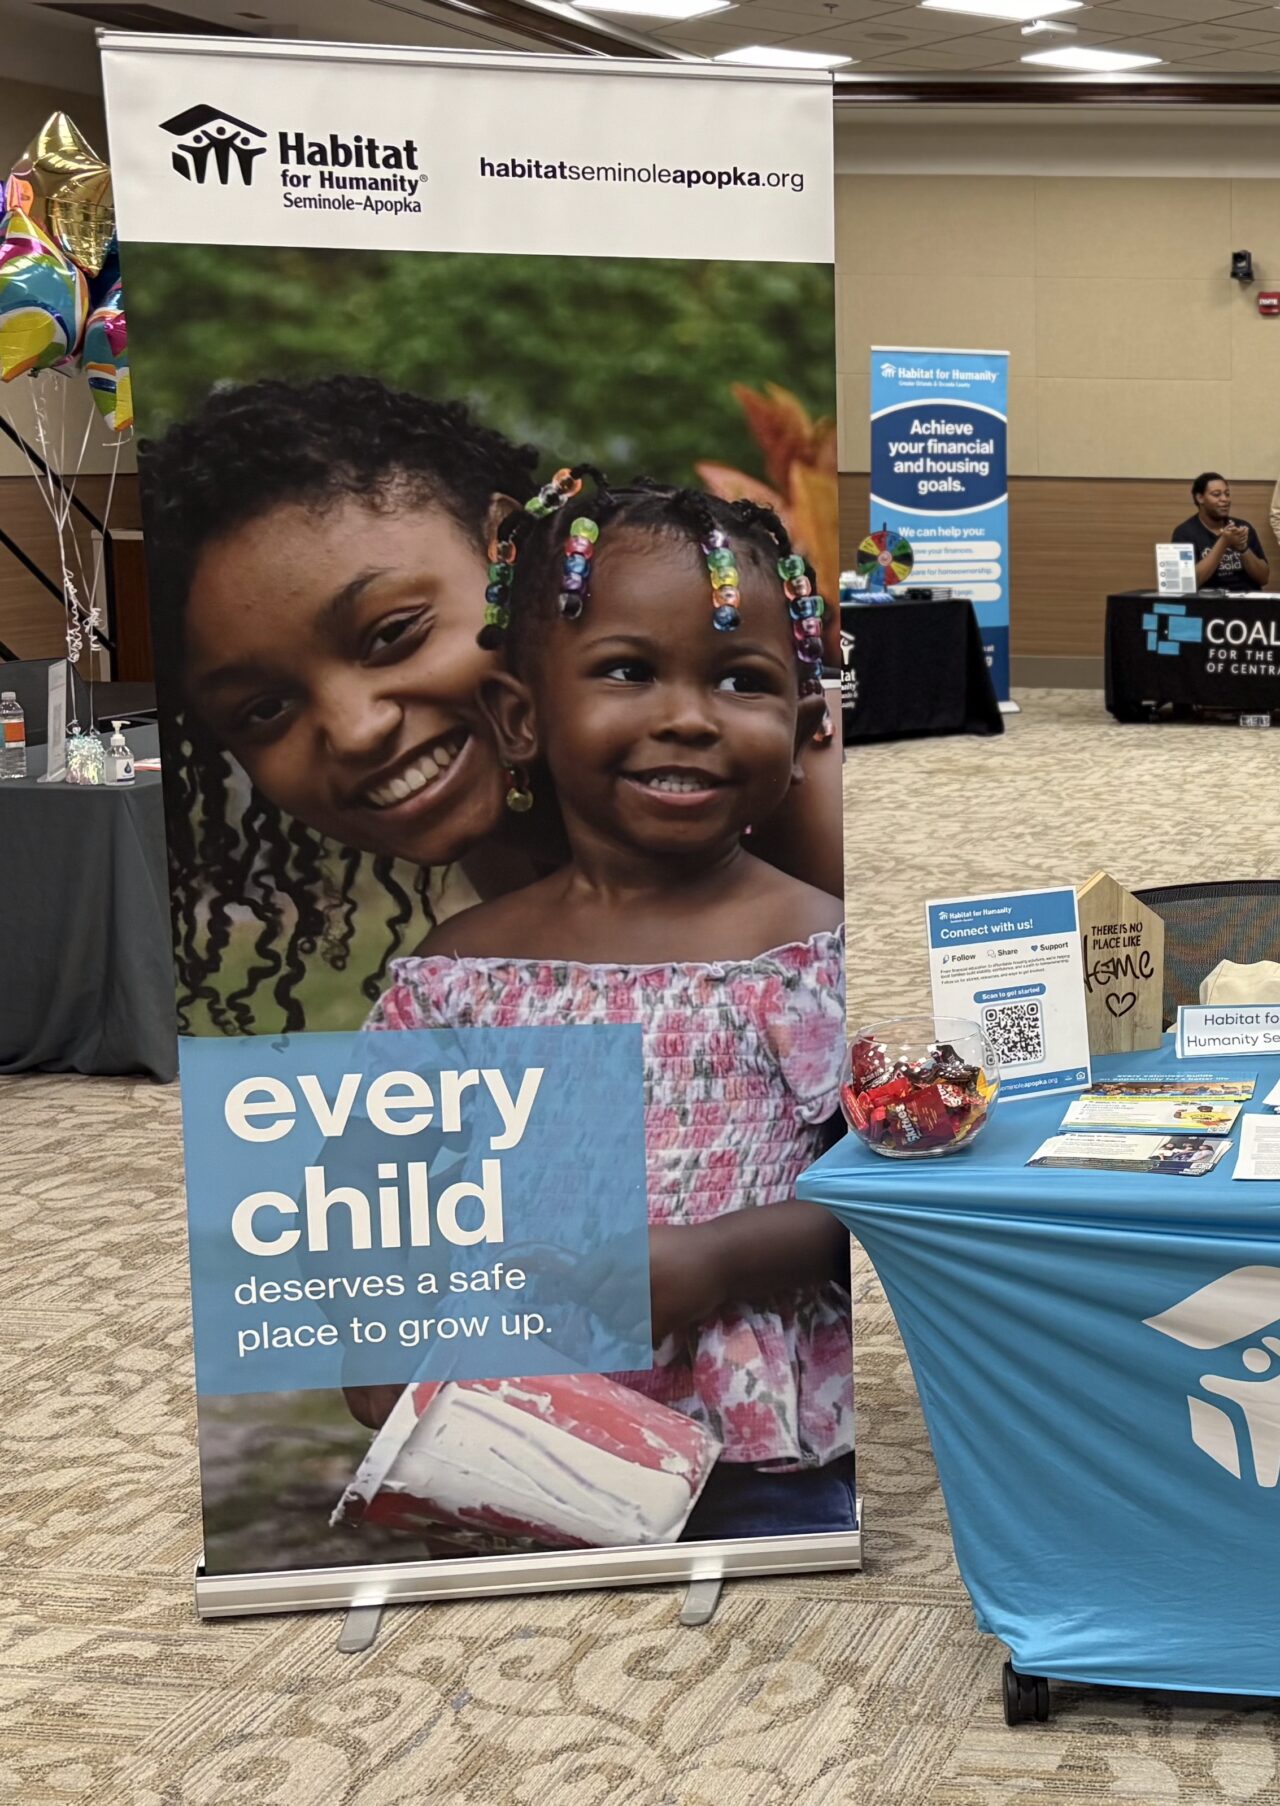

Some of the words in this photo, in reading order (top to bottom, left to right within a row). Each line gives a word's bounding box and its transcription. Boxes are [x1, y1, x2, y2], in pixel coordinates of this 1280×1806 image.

[278, 131, 419, 171] Habitat
[281, 170, 312, 191] for
[479, 156, 804, 192] habitatseminoleapopka.org
[283, 191, 422, 215] Seminole-Apopka
[898, 368, 934, 379] Habitat
[936, 369, 949, 380] for
[952, 369, 996, 383] Humanity
[910, 419, 974, 435] Achieve
[888, 441, 925, 457] your
[927, 439, 994, 454] financial
[894, 458, 924, 473] and
[926, 458, 990, 476] housing
[917, 477, 966, 495] goals.
[898, 527, 916, 537] We
[916, 529, 936, 537] can
[938, 526, 962, 538] help
[963, 528, 986, 538] you:
[1209, 649, 1237, 661] FOR
[1246, 650, 1273, 661] THE
[1206, 662, 1225, 674] OF
[949, 911, 972, 919] Habitat
[940, 925, 989, 940] Connect
[991, 922, 1018, 934] with
[1019, 919, 1034, 930] us!
[1091, 924, 1118, 936] THERE
[1119, 924, 1127, 933] IS
[1129, 922, 1143, 933] NO
[1040, 942, 1069, 953] Support
[1093, 937, 1120, 950] PLACE
[1122, 935, 1141, 947] LIKE
[951, 953, 976, 962] Follow
[997, 948, 1018, 957] Share
[982, 992, 998, 1000] Scan
[1006, 989, 1017, 998] get
[1018, 986, 1040, 995] started
[1204, 1011, 1260, 1026] Habitat
[1187, 1033, 1258, 1047] Humanity
[224, 1067, 545, 1151] every
[231, 1158, 505, 1257] child
[234, 1275, 406, 1305] deserves
[417, 1272, 439, 1294] a
[449, 1263, 527, 1292] safe
[237, 1321, 339, 1357] place
[350, 1317, 387, 1344] to
[399, 1313, 489, 1348] grow
[501, 1312, 552, 1341] up.
